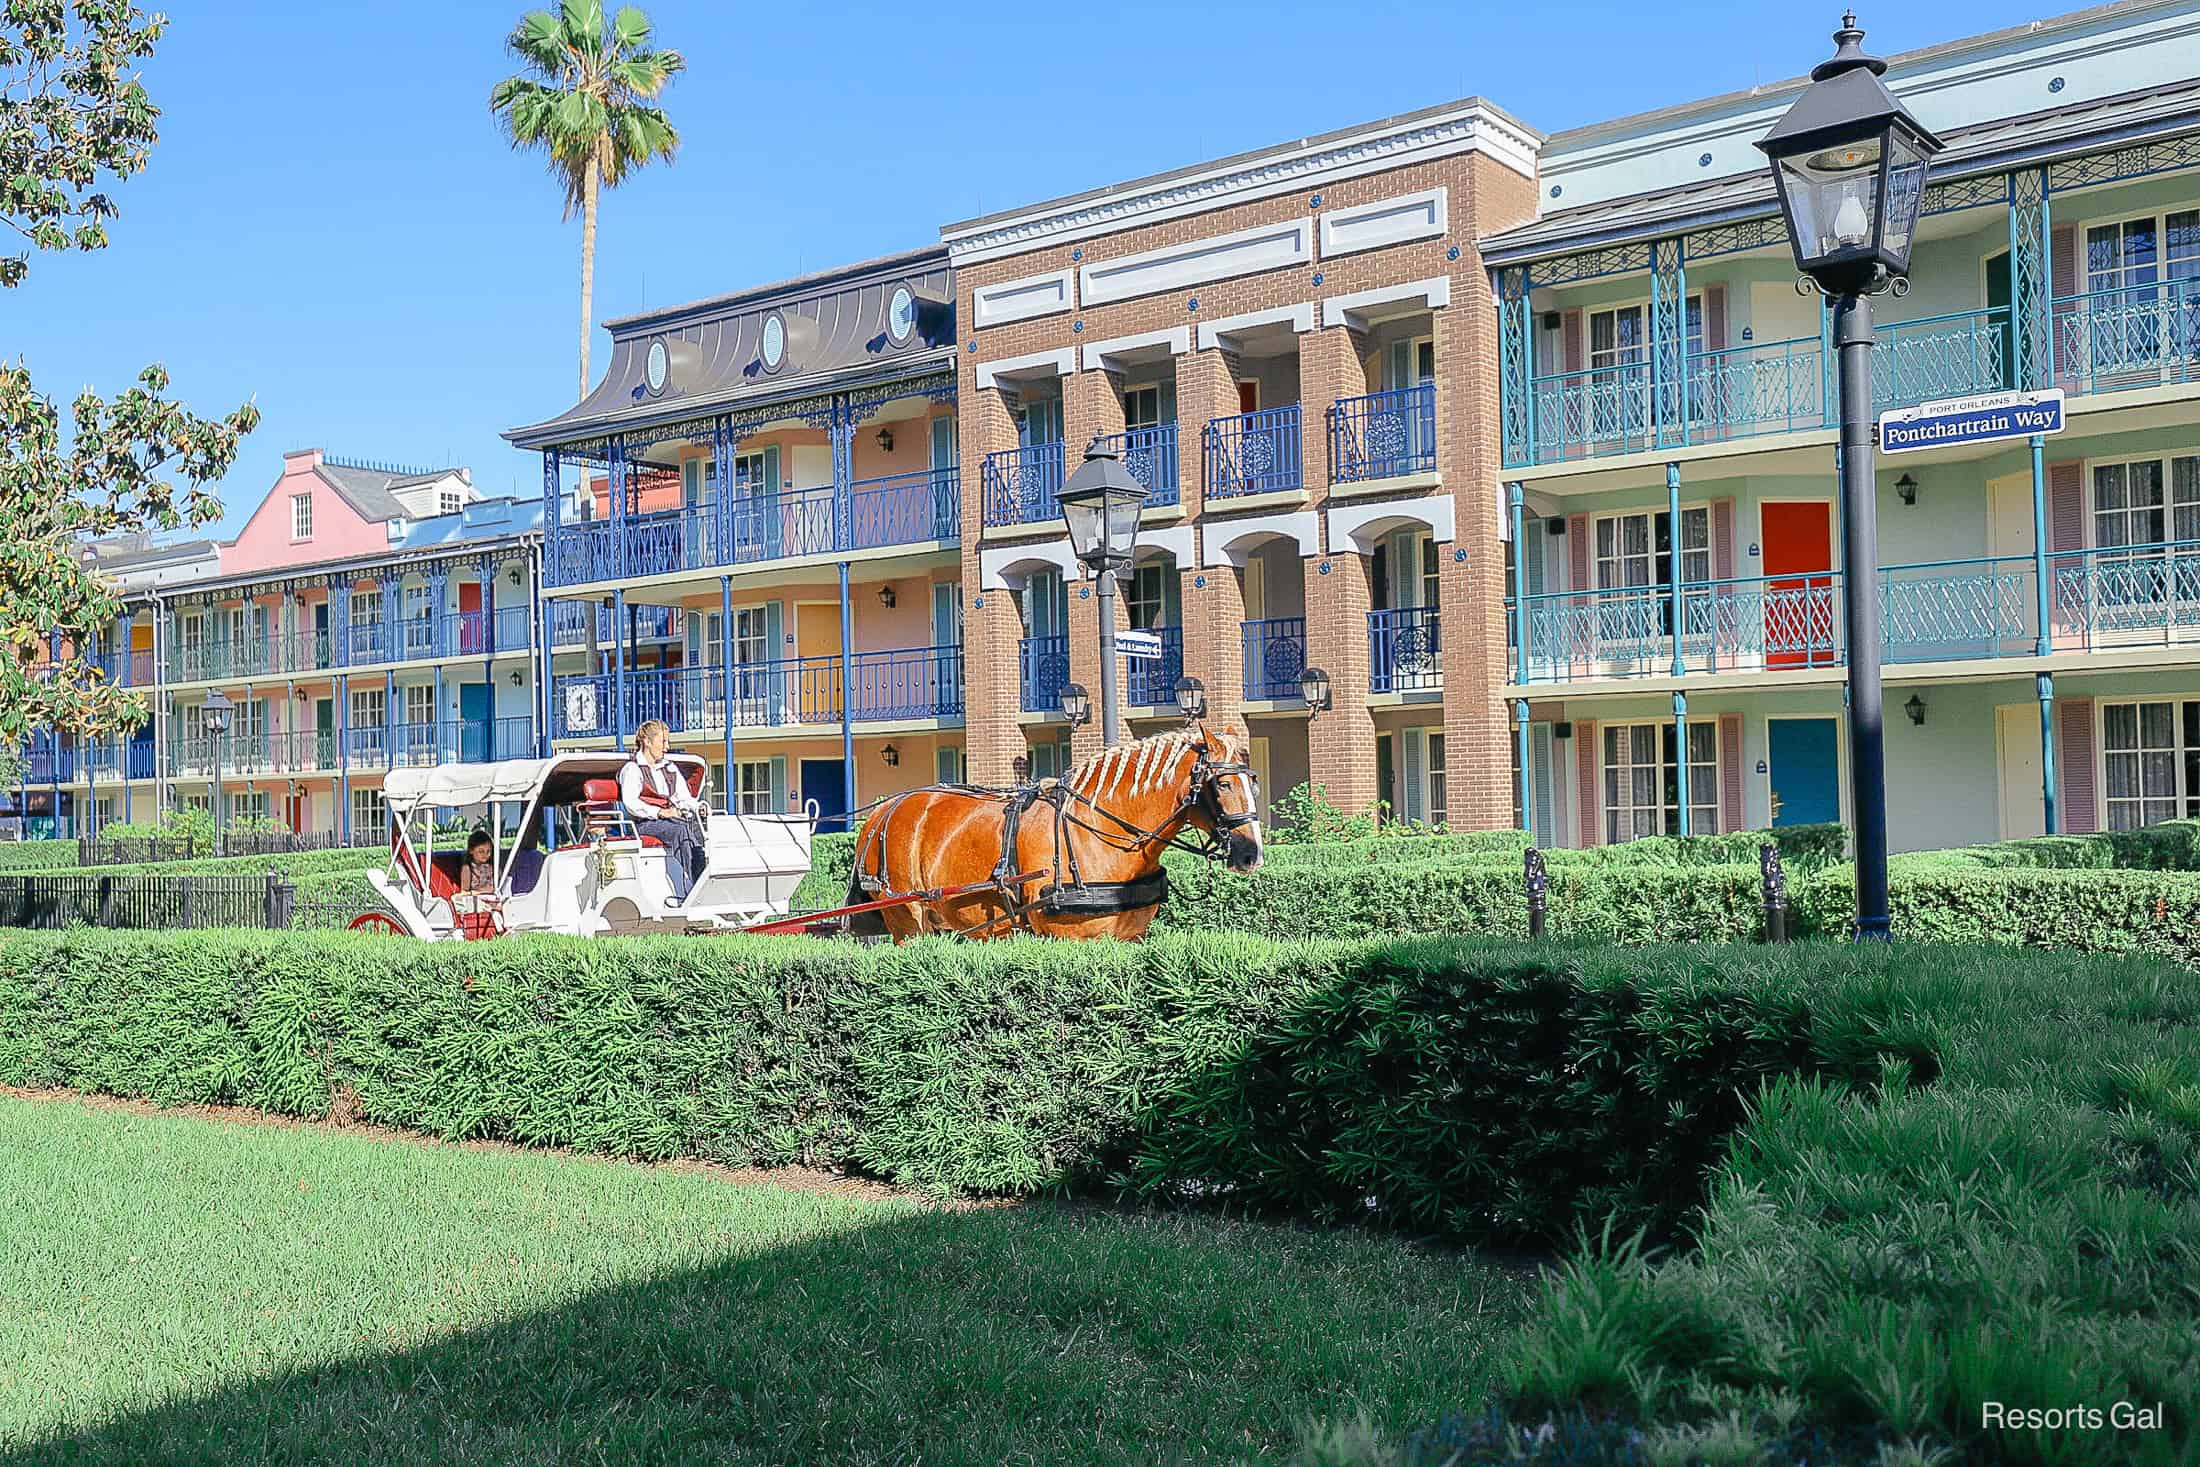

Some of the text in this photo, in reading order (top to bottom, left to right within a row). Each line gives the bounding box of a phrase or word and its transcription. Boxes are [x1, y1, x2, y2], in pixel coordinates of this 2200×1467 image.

[1929, 398, 2011, 415] PORT ORLEANS
[1887, 410, 2056, 444] Pontchartrain Way
